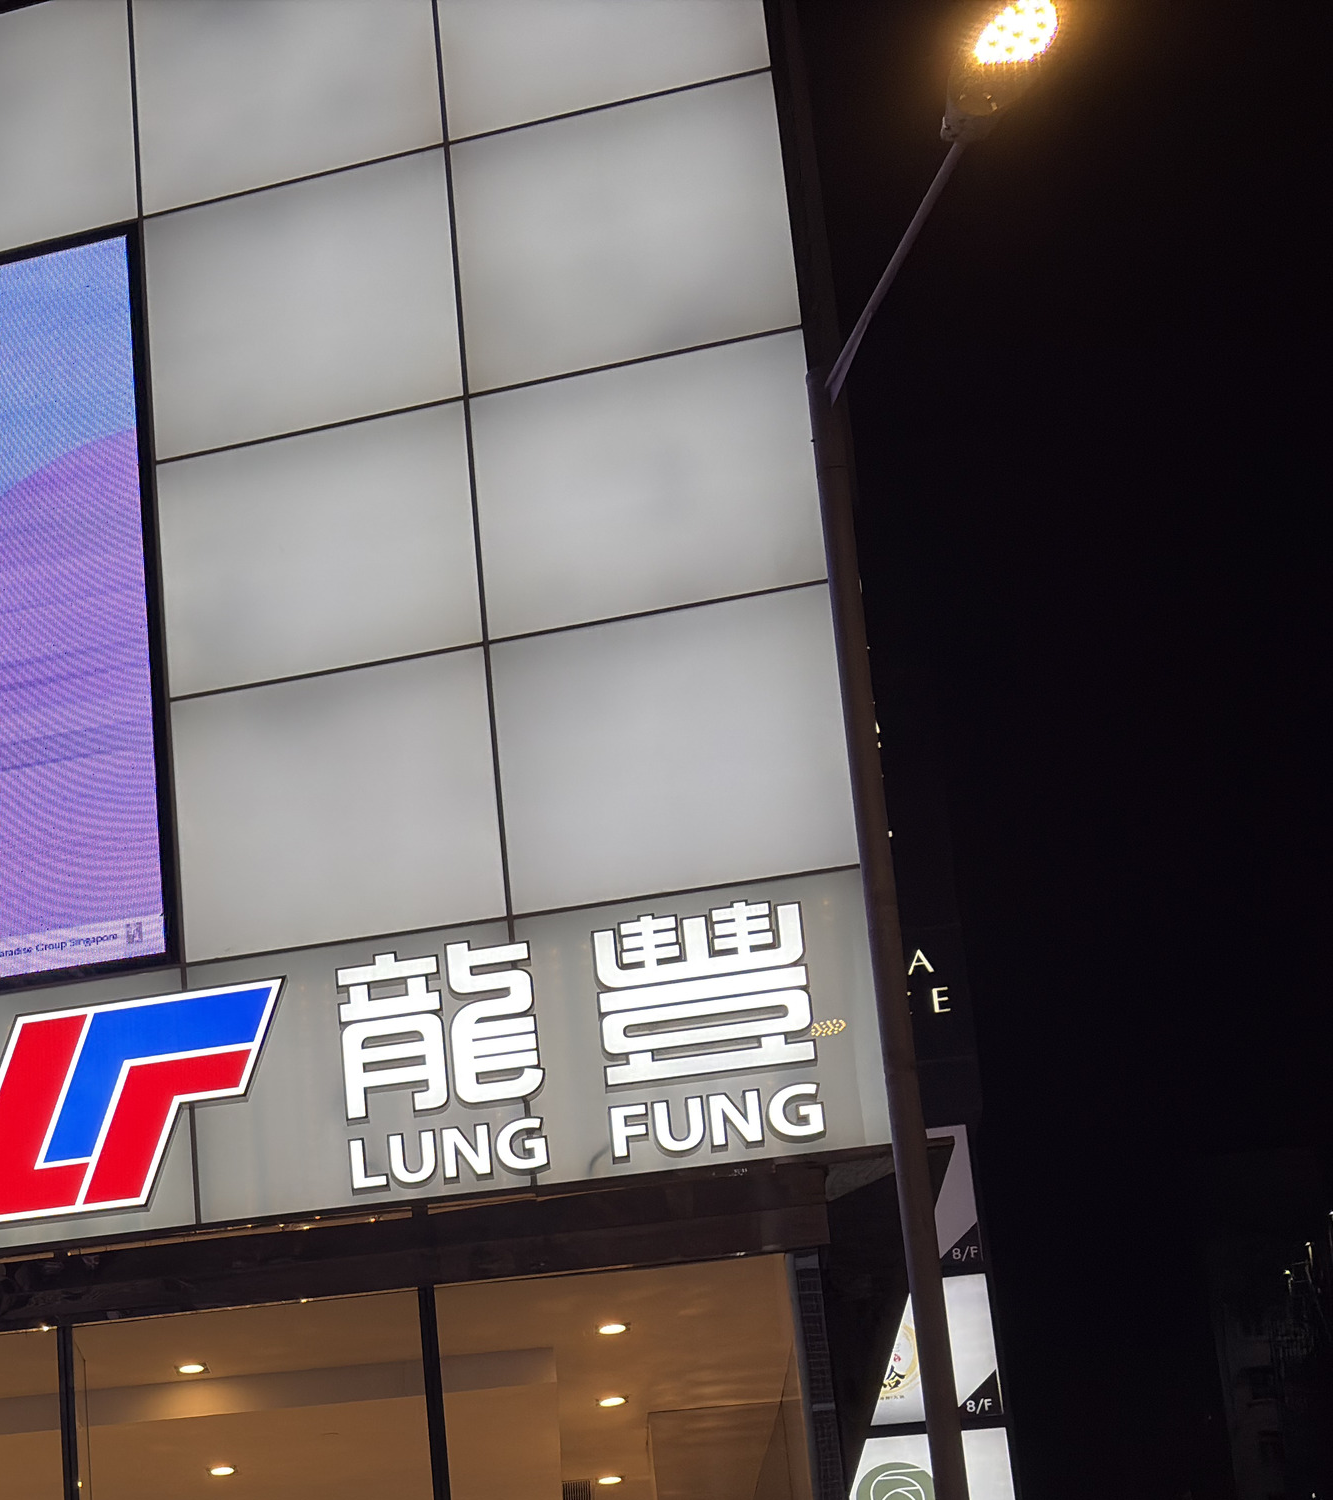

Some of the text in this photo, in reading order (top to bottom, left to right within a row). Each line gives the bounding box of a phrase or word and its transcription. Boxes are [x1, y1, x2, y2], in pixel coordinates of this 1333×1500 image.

[35, 939, 68, 953] Group
[69, 932, 118, 949] Singapore
[347, 1082, 826, 1195] LUNG FUNG
[952, 1246, 979, 1262] 8/F
[966, 1398, 992, 1415] 8/F
